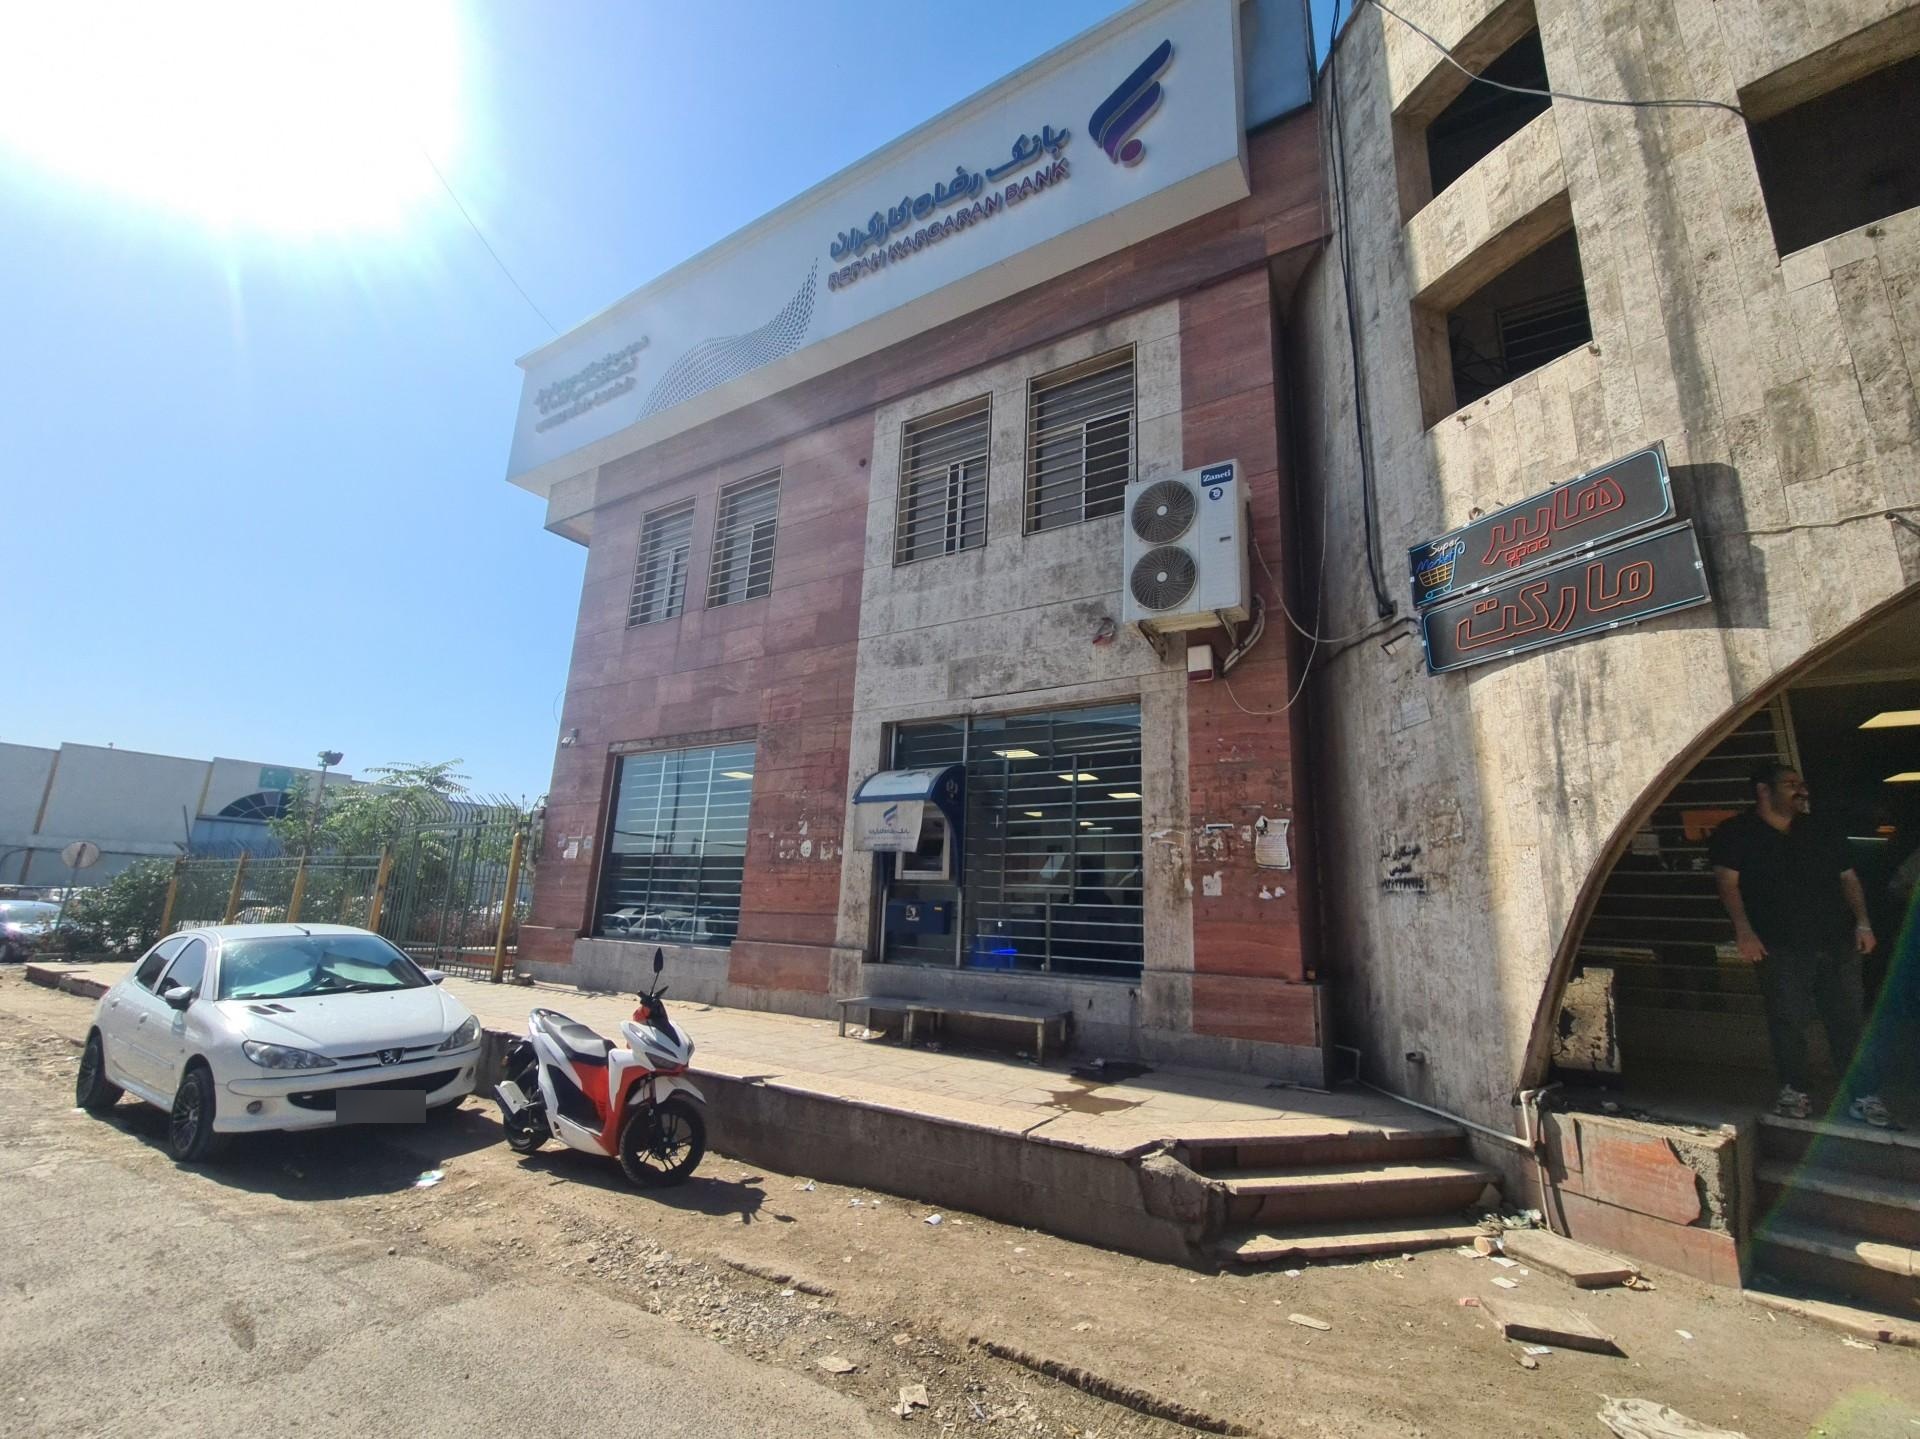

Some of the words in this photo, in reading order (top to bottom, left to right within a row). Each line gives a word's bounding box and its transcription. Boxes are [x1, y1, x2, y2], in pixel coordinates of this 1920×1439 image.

[985, 125, 1071, 181] بانک
[887, 191, 1003, 264] KARGARAN
[1004, 157, 1071, 207] BANK
[911, 165, 984, 219] رفاه
[830, 196, 913, 261] کارگران
[1429, 537, 1461, 557] Super
[1481, 476, 1625, 568] هایپر
[1456, 560, 1654, 650] مارکت
